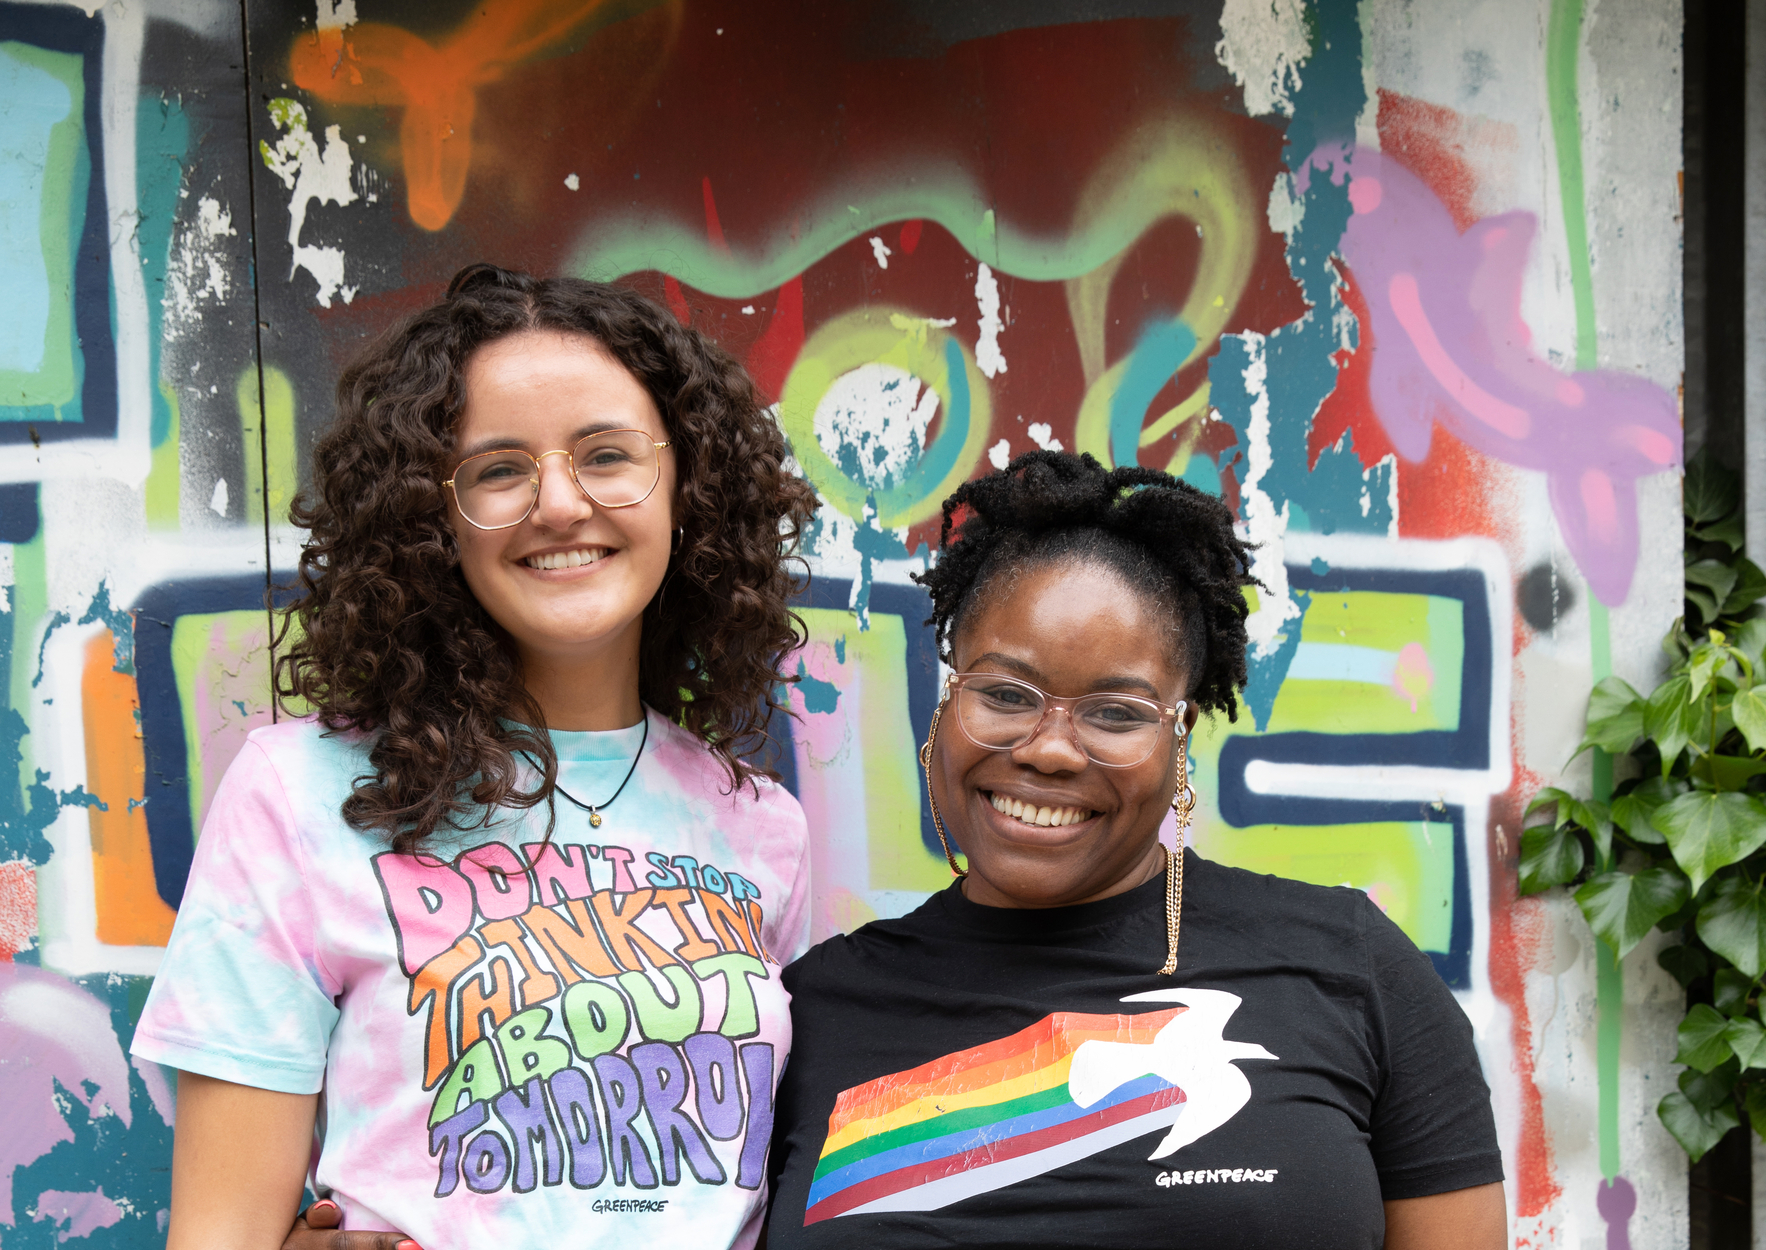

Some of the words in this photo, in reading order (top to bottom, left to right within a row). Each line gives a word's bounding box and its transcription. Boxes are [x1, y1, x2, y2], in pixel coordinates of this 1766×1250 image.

[370, 841, 636, 978] DON'T
[645, 851, 762, 902] STOP
[427, 952, 770, 1131] ABOUT
[591, 1199, 669, 1214] GREENPEACE
[1155, 1168, 1279, 1188] GREENPEACE
